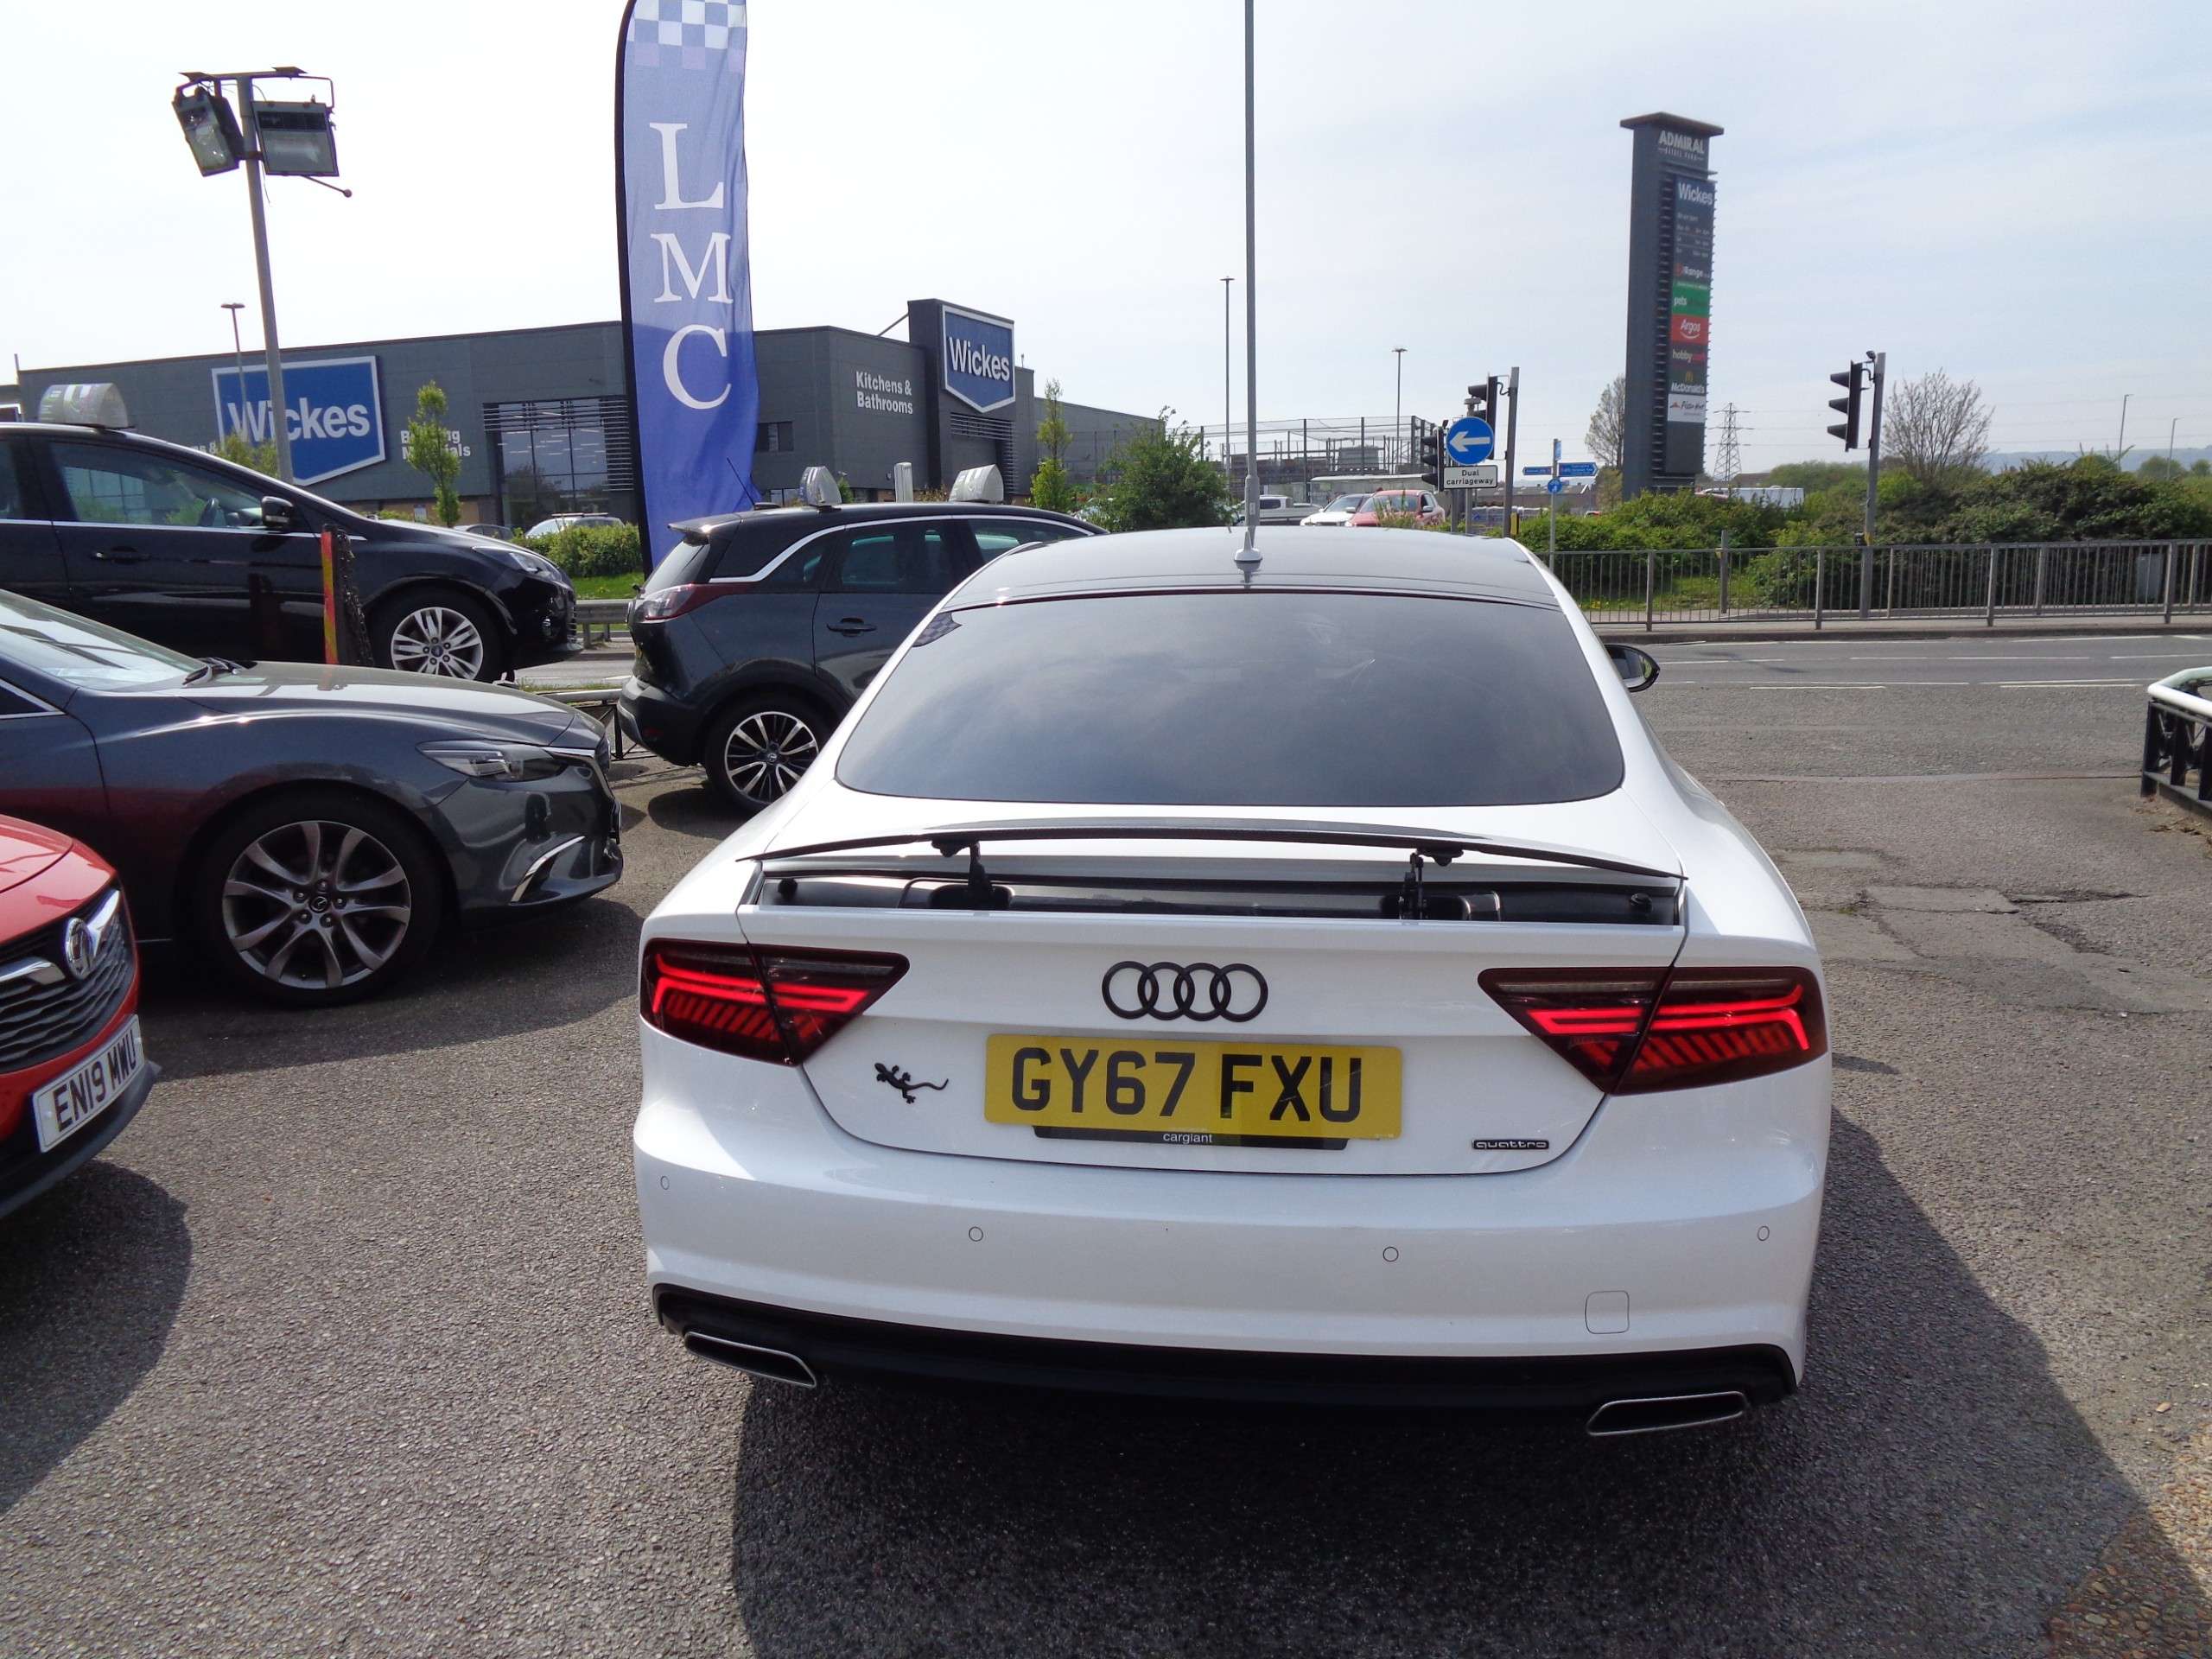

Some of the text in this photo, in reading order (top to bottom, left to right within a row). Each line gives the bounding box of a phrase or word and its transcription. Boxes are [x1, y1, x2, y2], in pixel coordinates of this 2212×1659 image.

[1658, 130, 1705, 154] ADMIRAL
[1678, 181, 1713, 206] Wickes
[649, 123, 733, 410] LMC
[1680, 318, 1701, 334] Argos
[949, 336, 1010, 382] Wickes
[855, 371, 912, 396] Kitchens &
[856, 391, 913, 415] Bathrooms
[53, 1060, 107, 1133] EN19
[1011, 1046, 1362, 1123] GY67 FXU
[1162, 1133, 1213, 1145] cargiant
[1476, 1141, 1547, 1149] quattro
